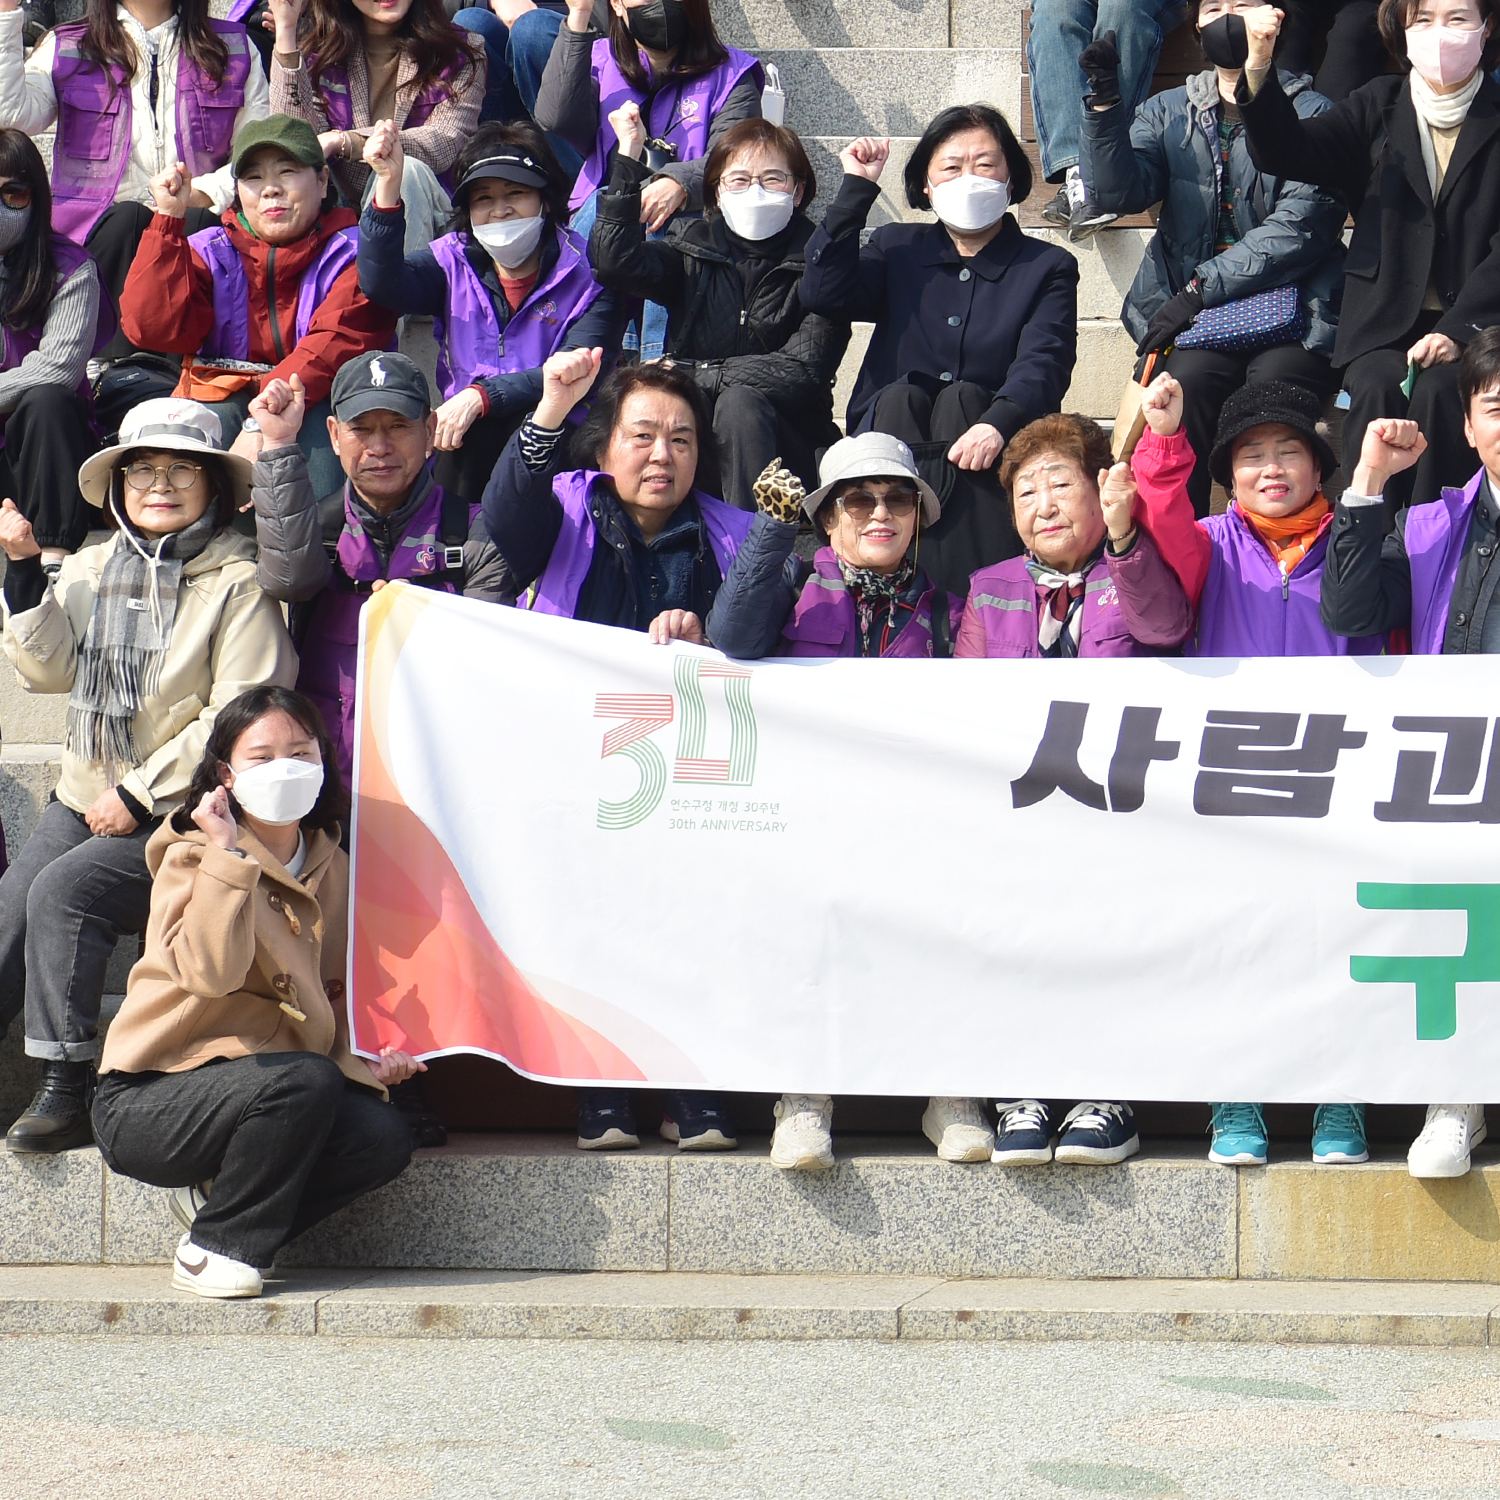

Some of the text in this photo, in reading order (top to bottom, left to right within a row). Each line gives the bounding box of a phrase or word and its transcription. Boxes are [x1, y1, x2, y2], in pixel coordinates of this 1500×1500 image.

[670, 798, 781, 816] 연수구청 개청 30주년
[668, 818, 789, 833] 30th ANNIVERSARY
